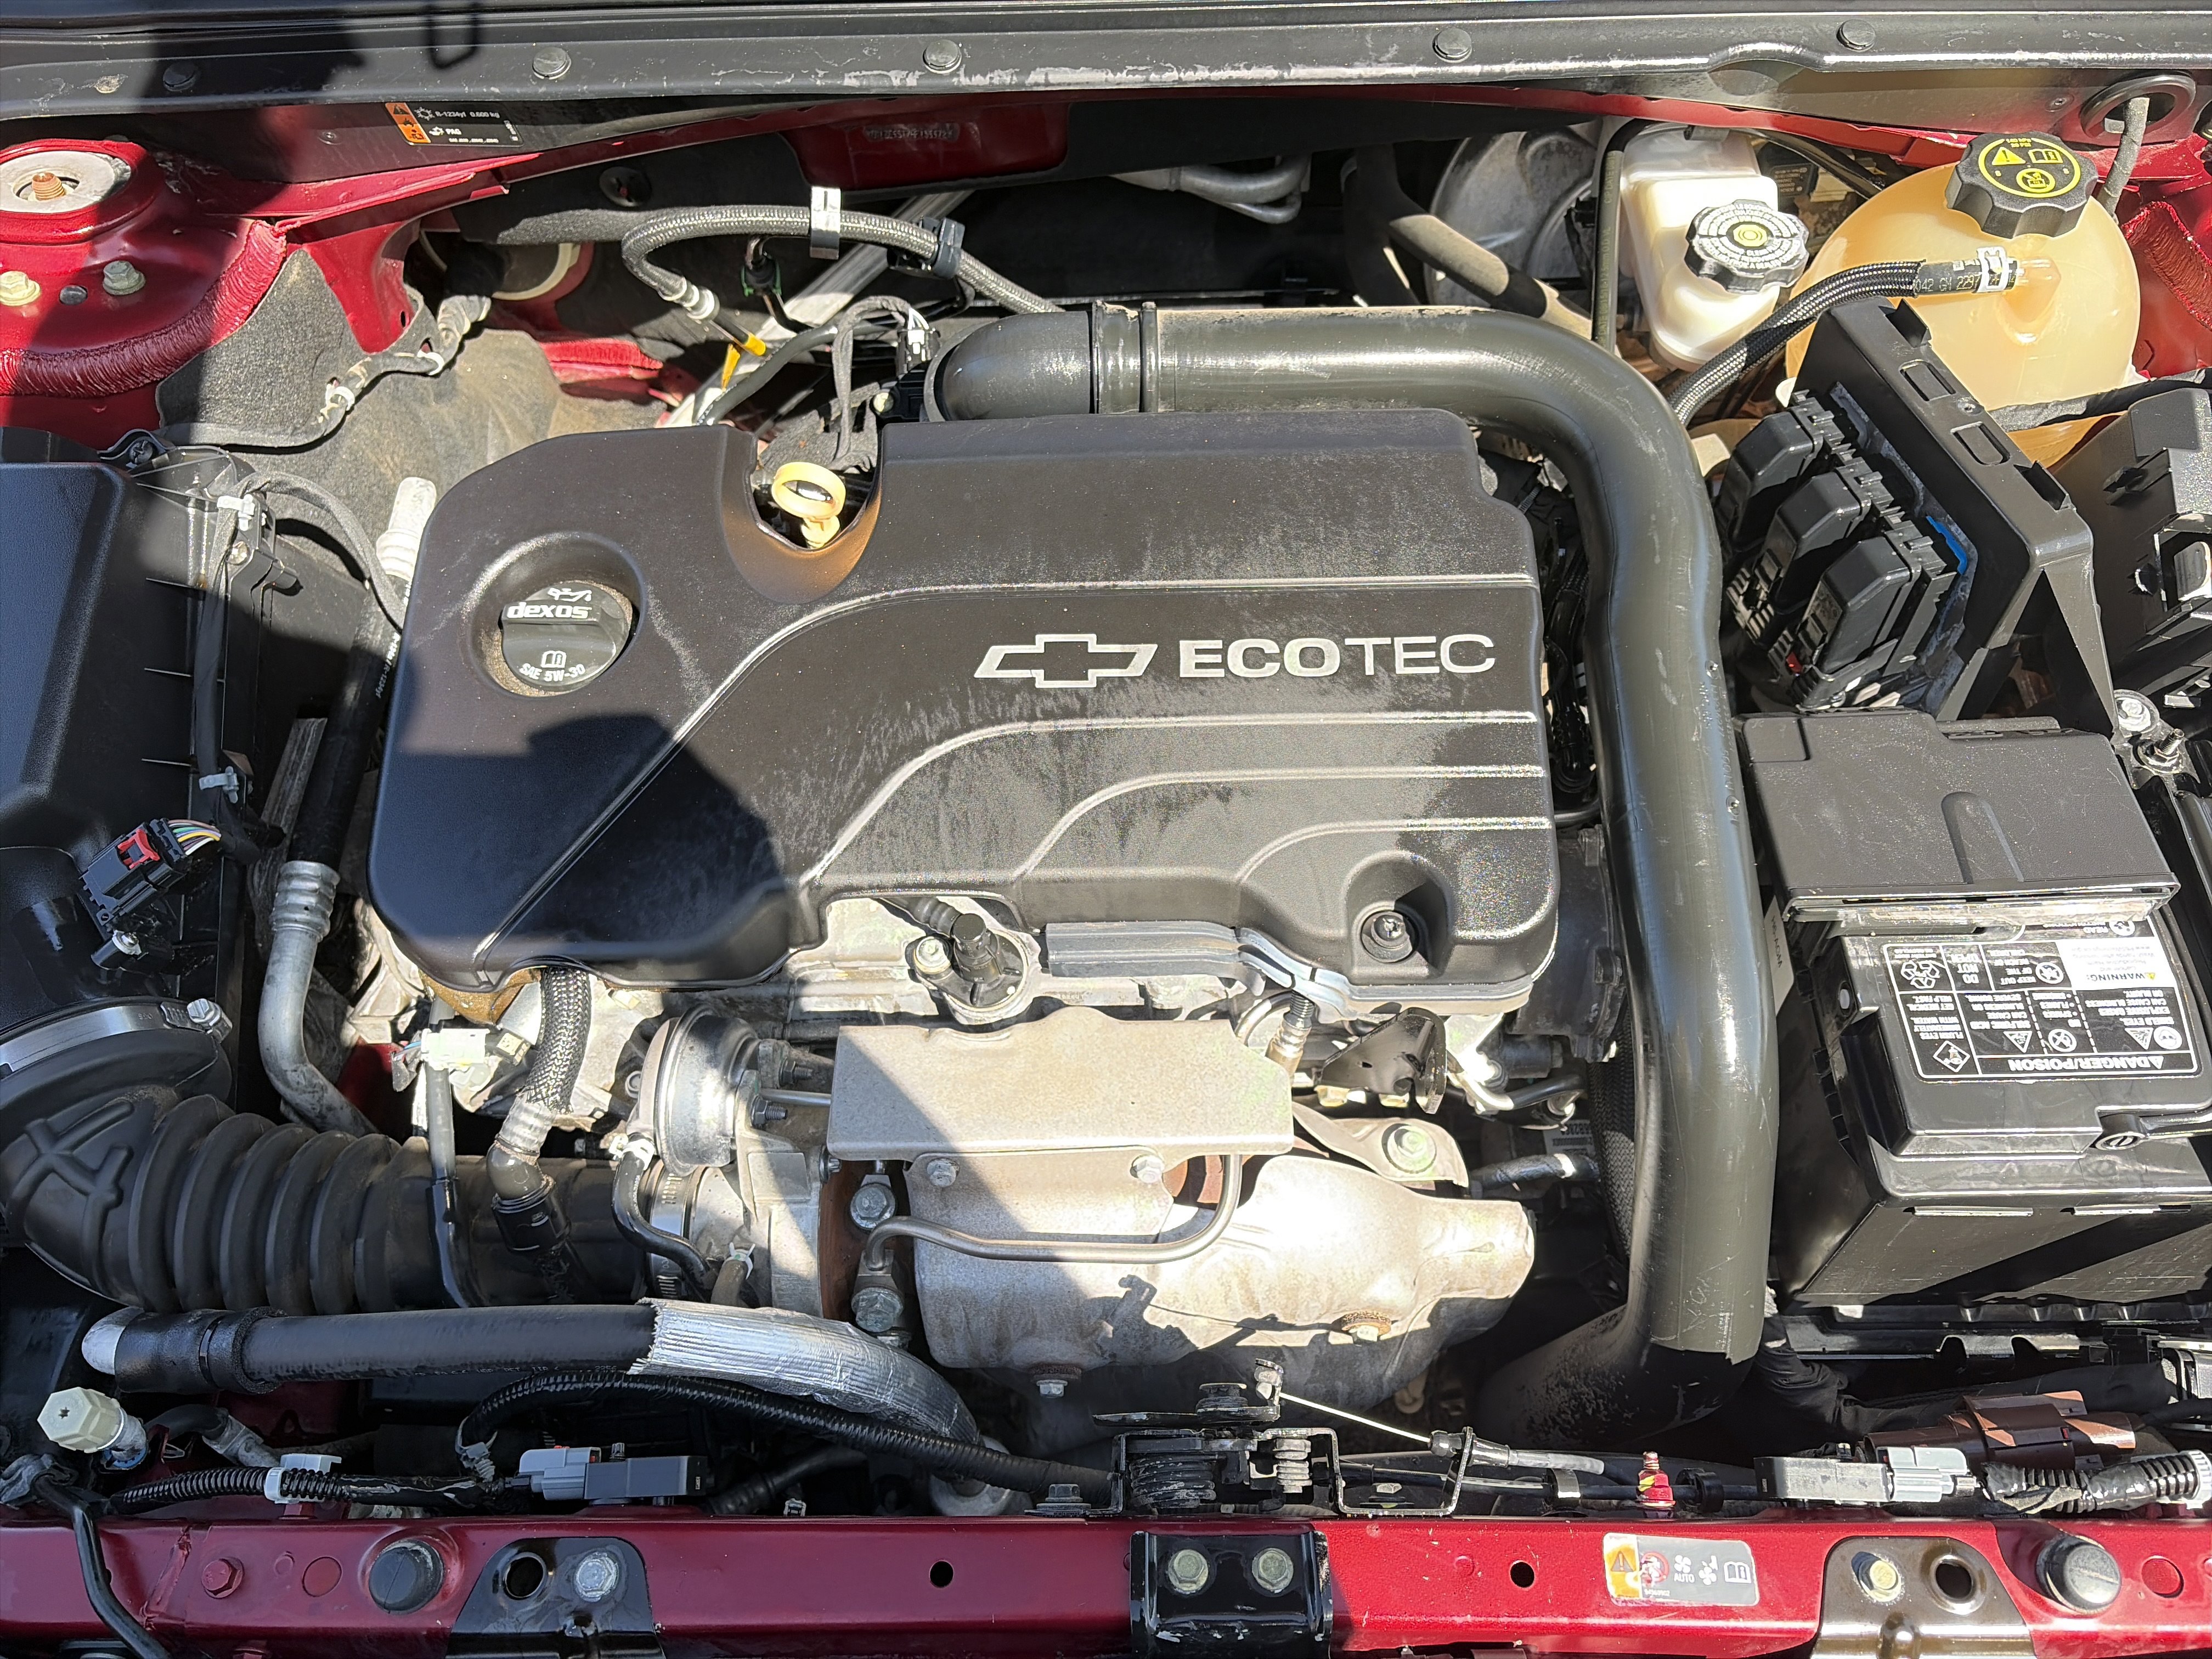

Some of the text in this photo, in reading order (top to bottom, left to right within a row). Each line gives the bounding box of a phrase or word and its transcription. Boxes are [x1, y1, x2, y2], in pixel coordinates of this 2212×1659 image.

[507, 601, 592, 619] dexos
[1179, 634, 1497, 678] ECOTEC
[519, 663, 586, 682] SAE 5W-30
[1957, 964, 1978, 973] NOT
[1962, 974, 1979, 983] DO
[2086, 973, 2145, 981] WARNING:
[2008, 1055, 2151, 1071] DANGER/POISON
[1674, 1572, 1695, 1583] AUTO
